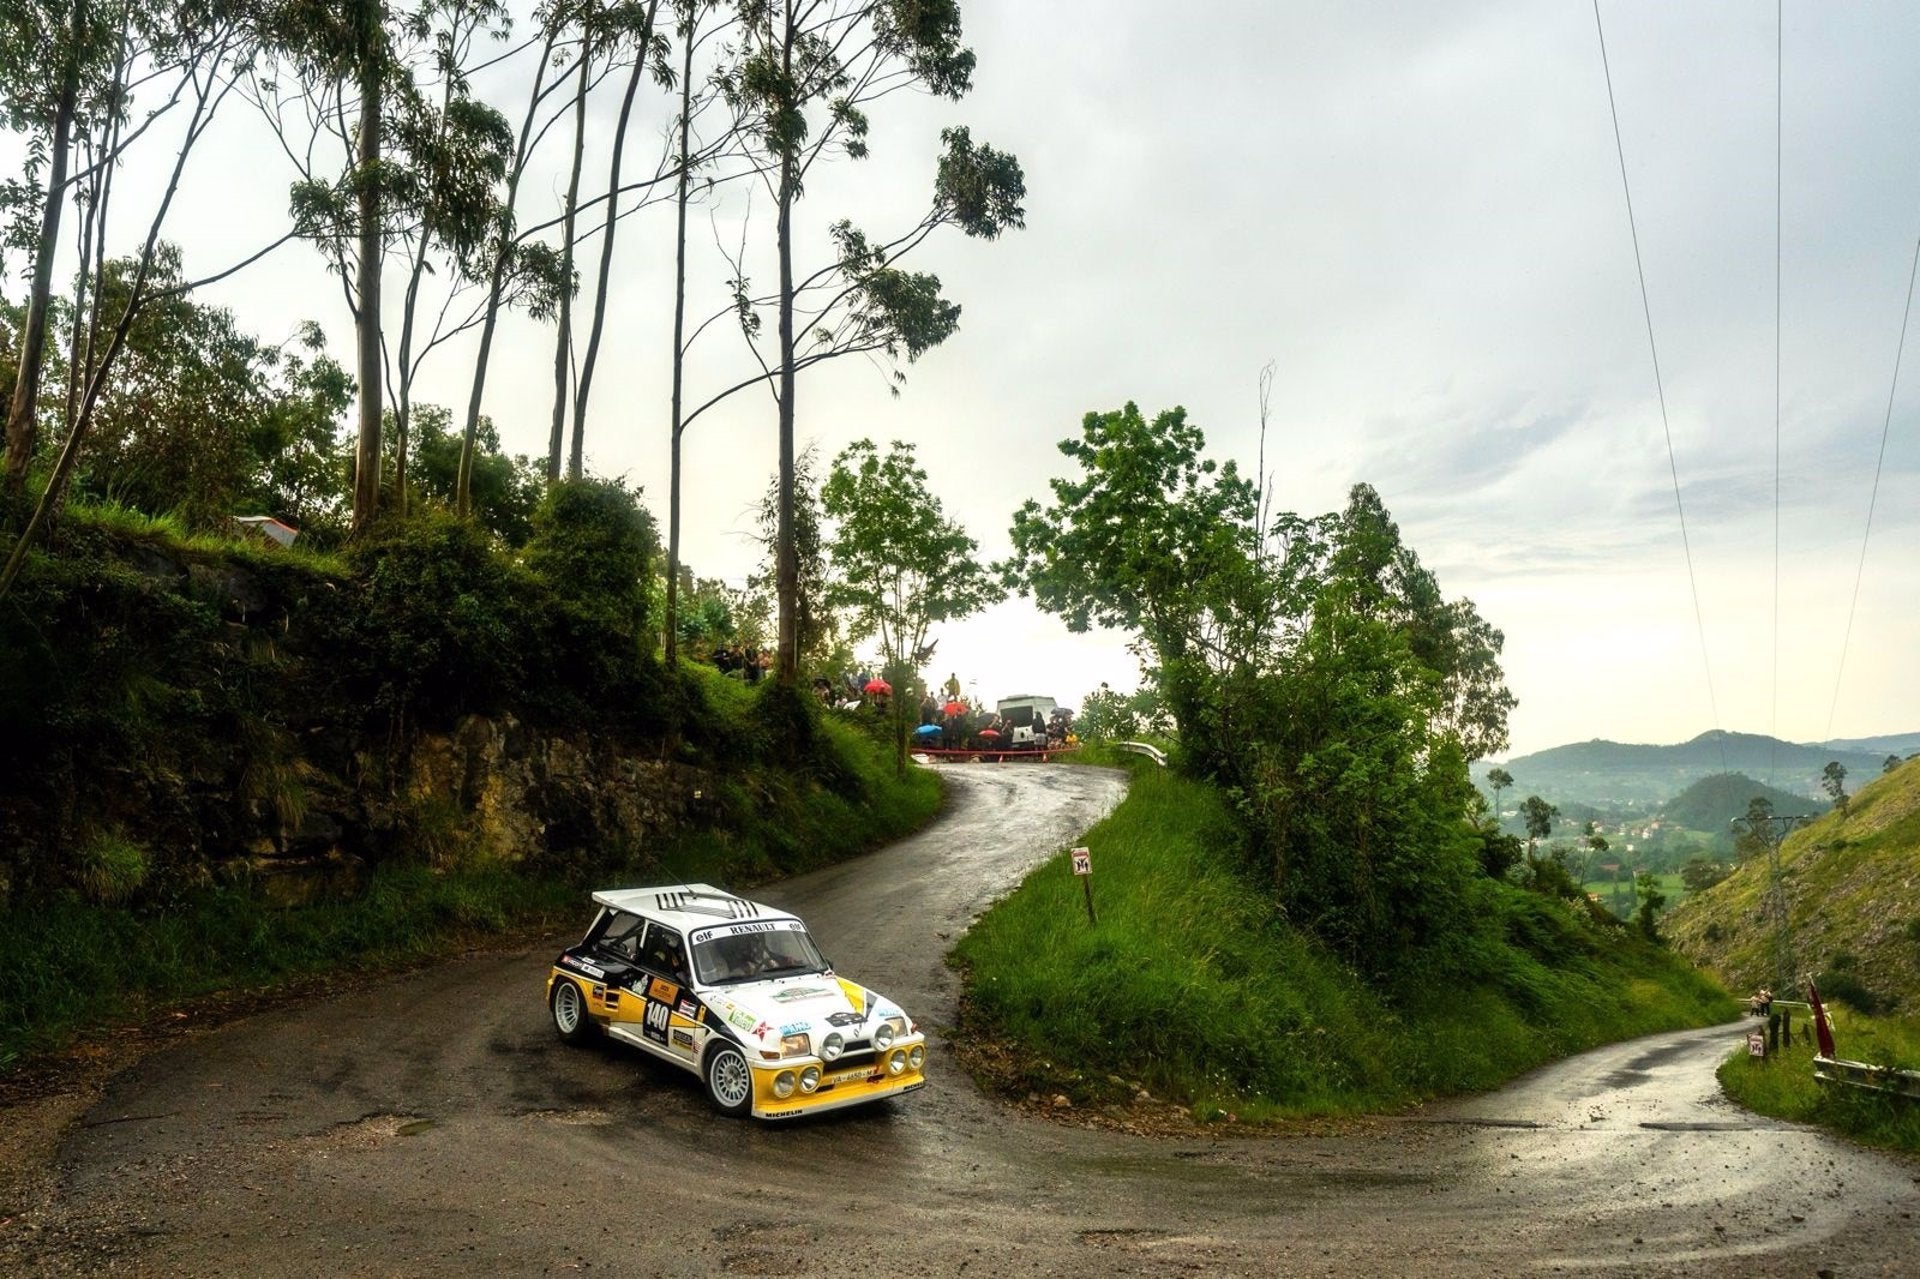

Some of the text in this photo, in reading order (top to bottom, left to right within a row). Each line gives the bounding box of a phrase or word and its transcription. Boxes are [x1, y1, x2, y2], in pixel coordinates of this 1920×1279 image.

[696, 930, 714, 943] elf
[729, 922, 776, 935] RENAULT
[646, 1000, 670, 1032] 140
[765, 1108, 803, 1118] MICHELIN
